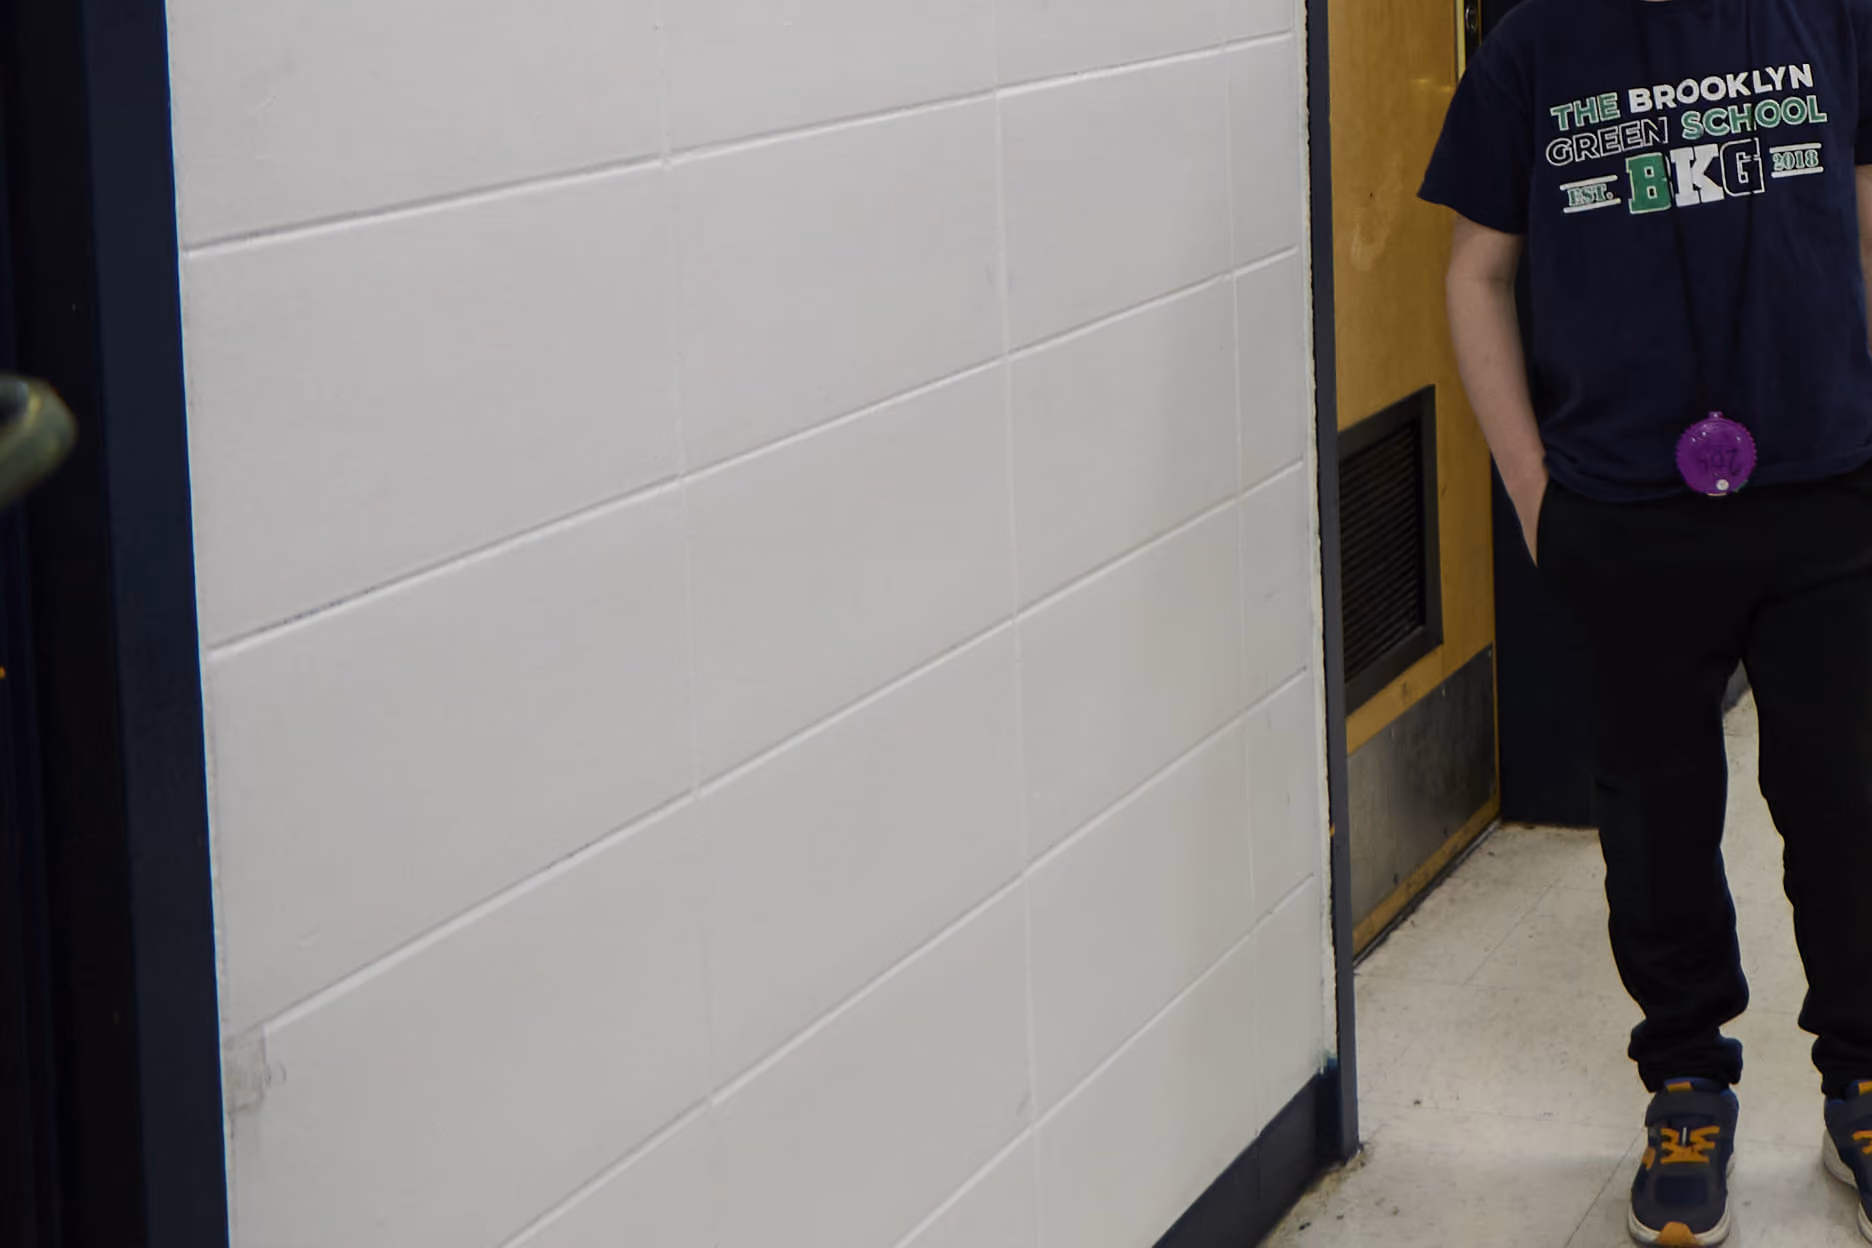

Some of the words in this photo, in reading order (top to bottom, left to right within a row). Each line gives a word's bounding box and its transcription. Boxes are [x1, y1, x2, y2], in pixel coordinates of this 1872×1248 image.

[1546, 117, 1669, 166] GREEN
[1681, 95, 1828, 140] SCHOOL
[1550, 92, 1621, 131] THE
[1628, 63, 1814, 114] BROOKLYN
[1567, 183, 1614, 207] EST.
[1625, 137, 1765, 215] BKG
[1771, 149, 1819, 172] 2018
